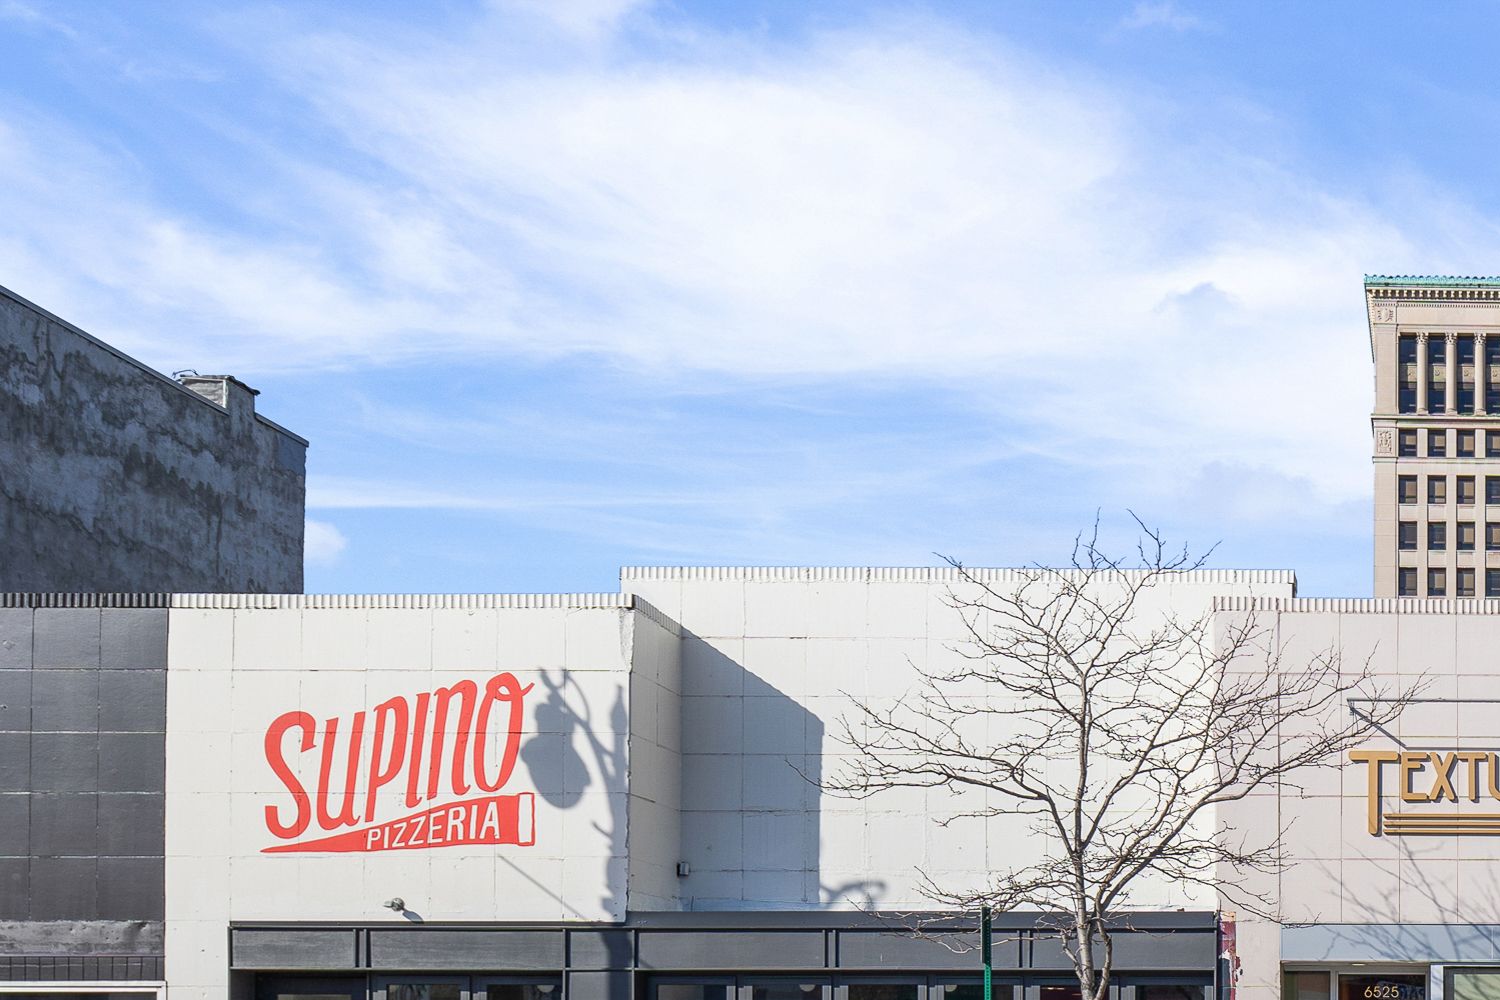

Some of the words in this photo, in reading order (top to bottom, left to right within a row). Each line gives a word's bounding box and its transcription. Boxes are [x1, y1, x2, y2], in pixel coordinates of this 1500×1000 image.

[264, 672, 535, 839] SUPINO
[366, 801, 500, 850] PIZZERIA
[1364, 985, 1399, 998] 6525
